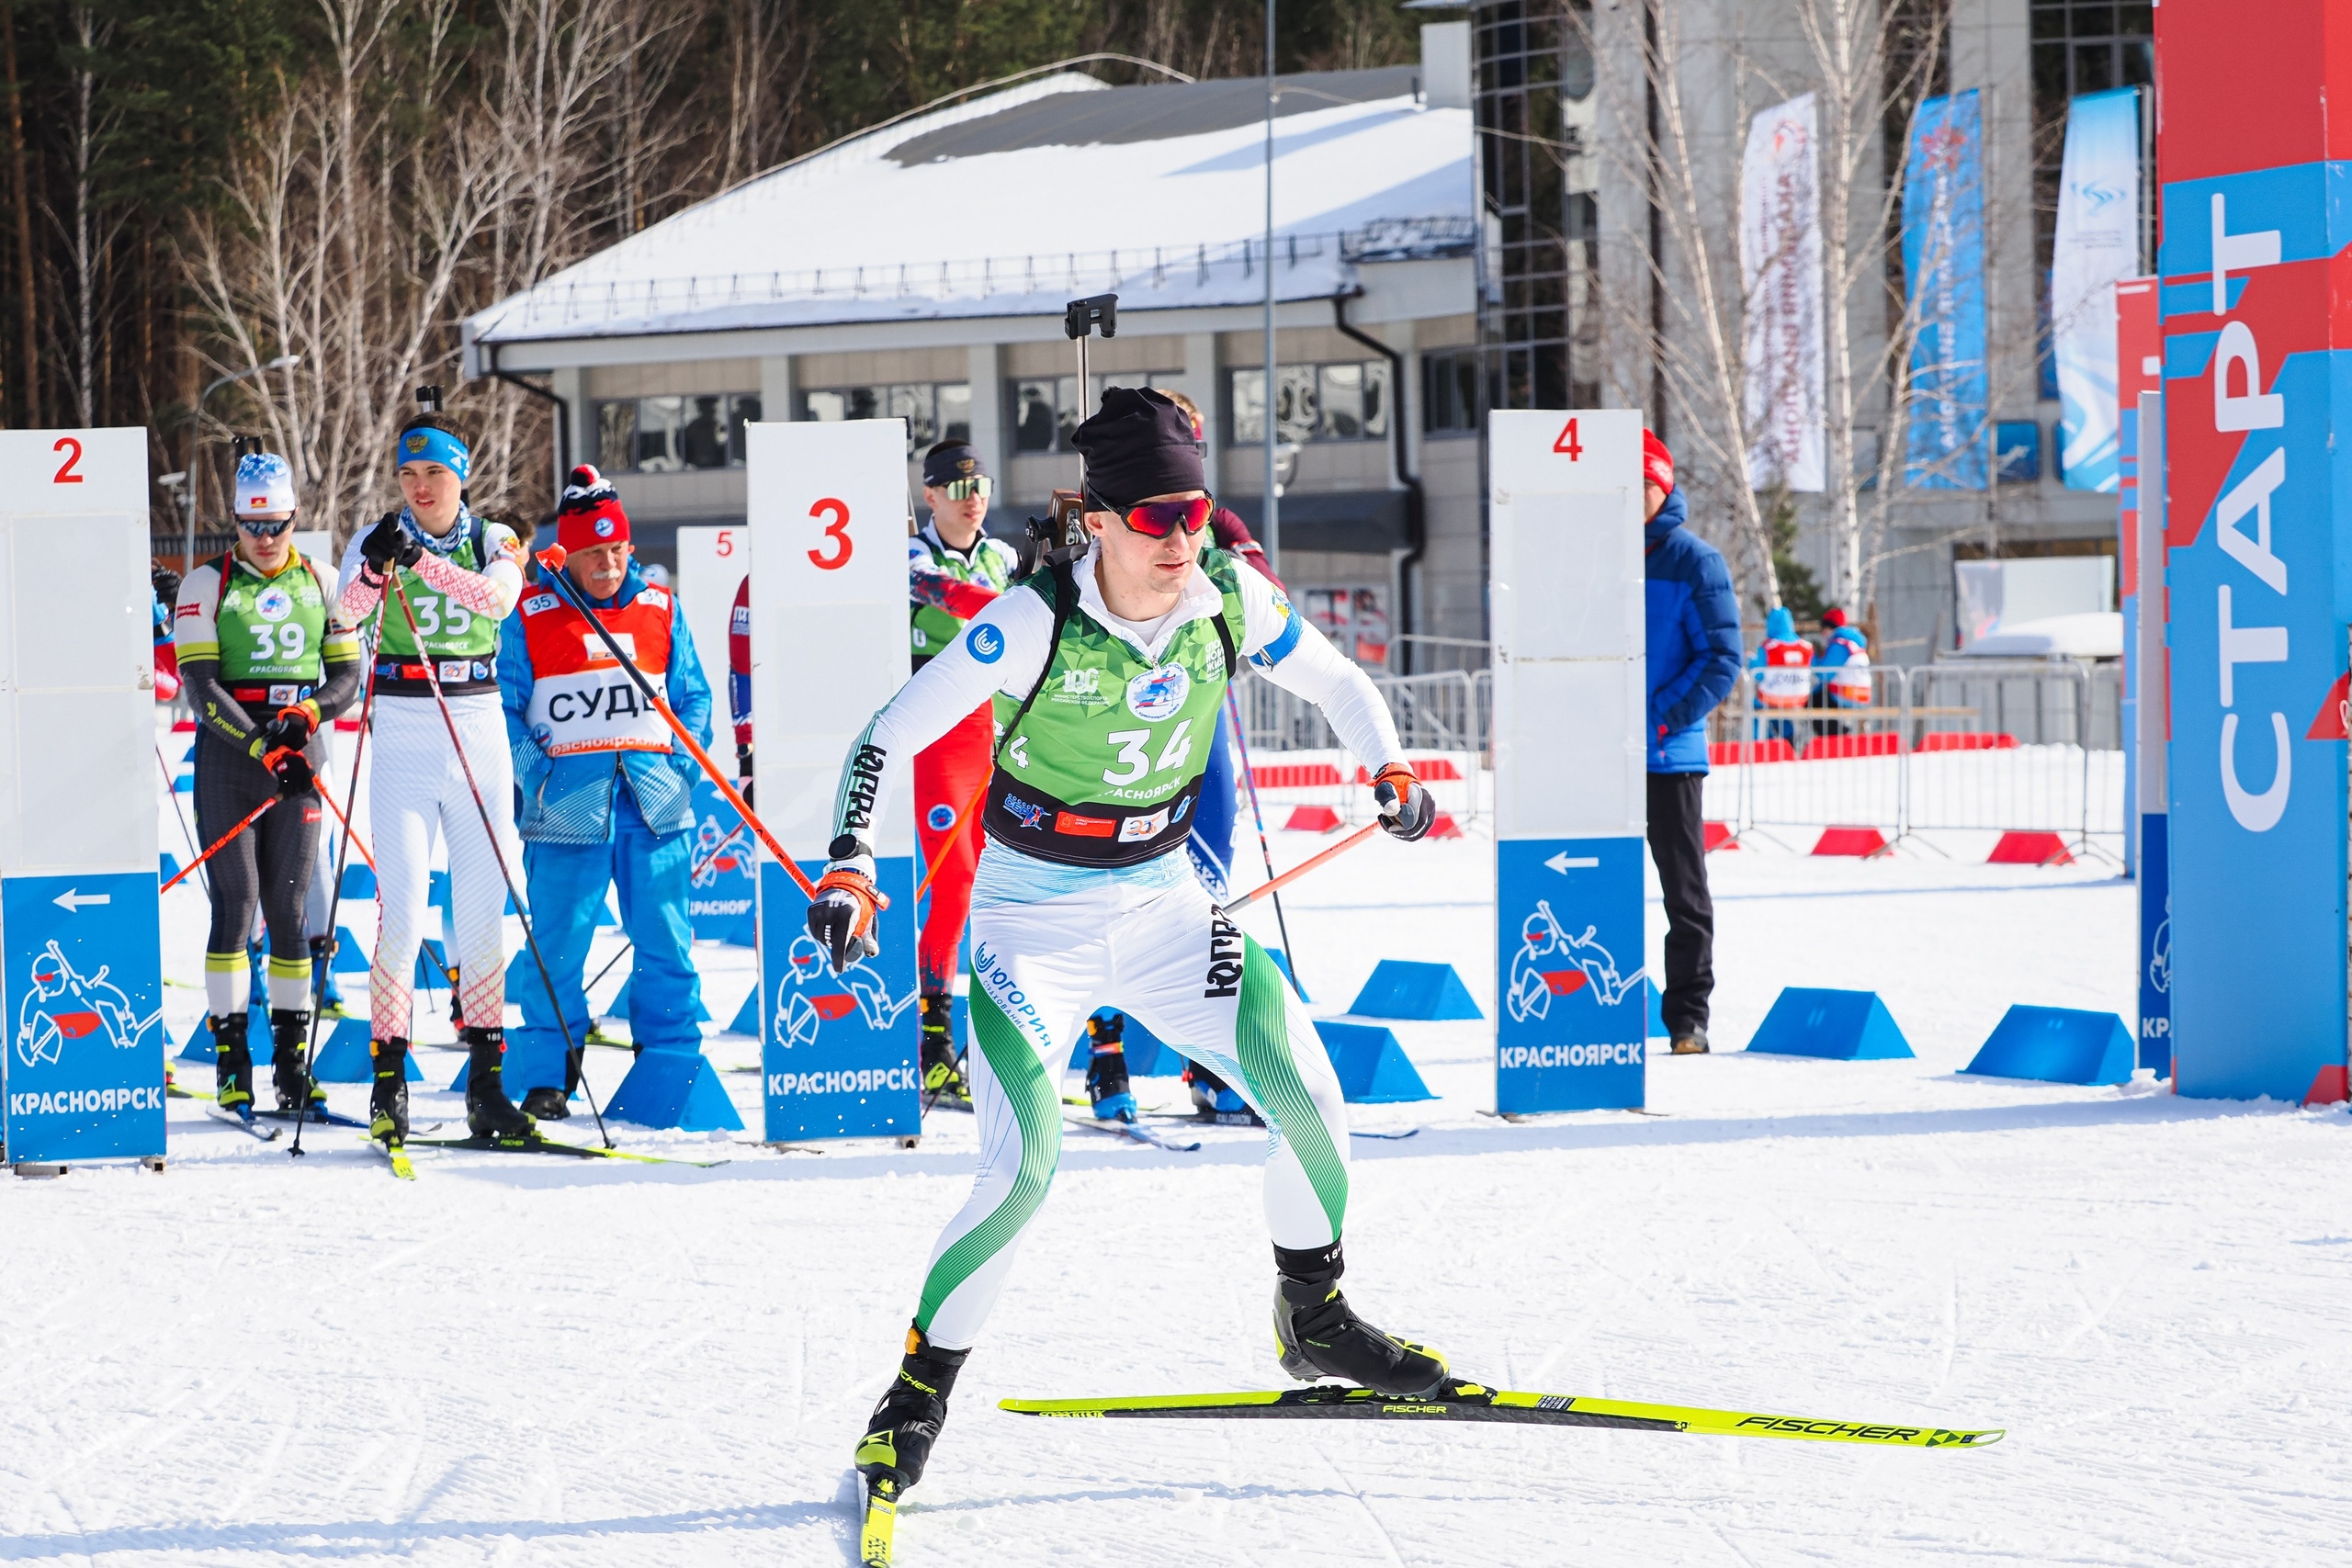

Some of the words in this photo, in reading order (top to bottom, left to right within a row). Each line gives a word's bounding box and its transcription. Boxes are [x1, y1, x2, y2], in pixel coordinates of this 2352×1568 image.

[1553, 417, 1584, 462] 4
[52, 436, 84, 484] 2
[2211, 193, 2292, 833] СТАРТ
[716, 531, 733, 558] 5
[807, 497, 854, 570] 3
[413, 595, 471, 637] 35
[529, 594, 551, 612] 35
[249, 622, 306, 660] 39
[424, 640, 469, 650] РАСНОЯРСК
[1102, 716, 1194, 787] 34
[1098, 774, 1182, 800] АСНОЯРСК
[982, 979, 1026, 1030] СТРАХОВАНИЕ
[989, 967, 1051, 1047] ЮГОРИЯ
[1499, 1042, 1644, 1069] КРАСНОЯРСК
[768, 1067, 918, 1097] КРАСНОЯРСК
[10, 1086, 163, 1117] КРАСНОЯРСК
[1382, 1404, 1447, 1414] FISCHER
[1735, 1416, 1921, 1442] FISCHER
